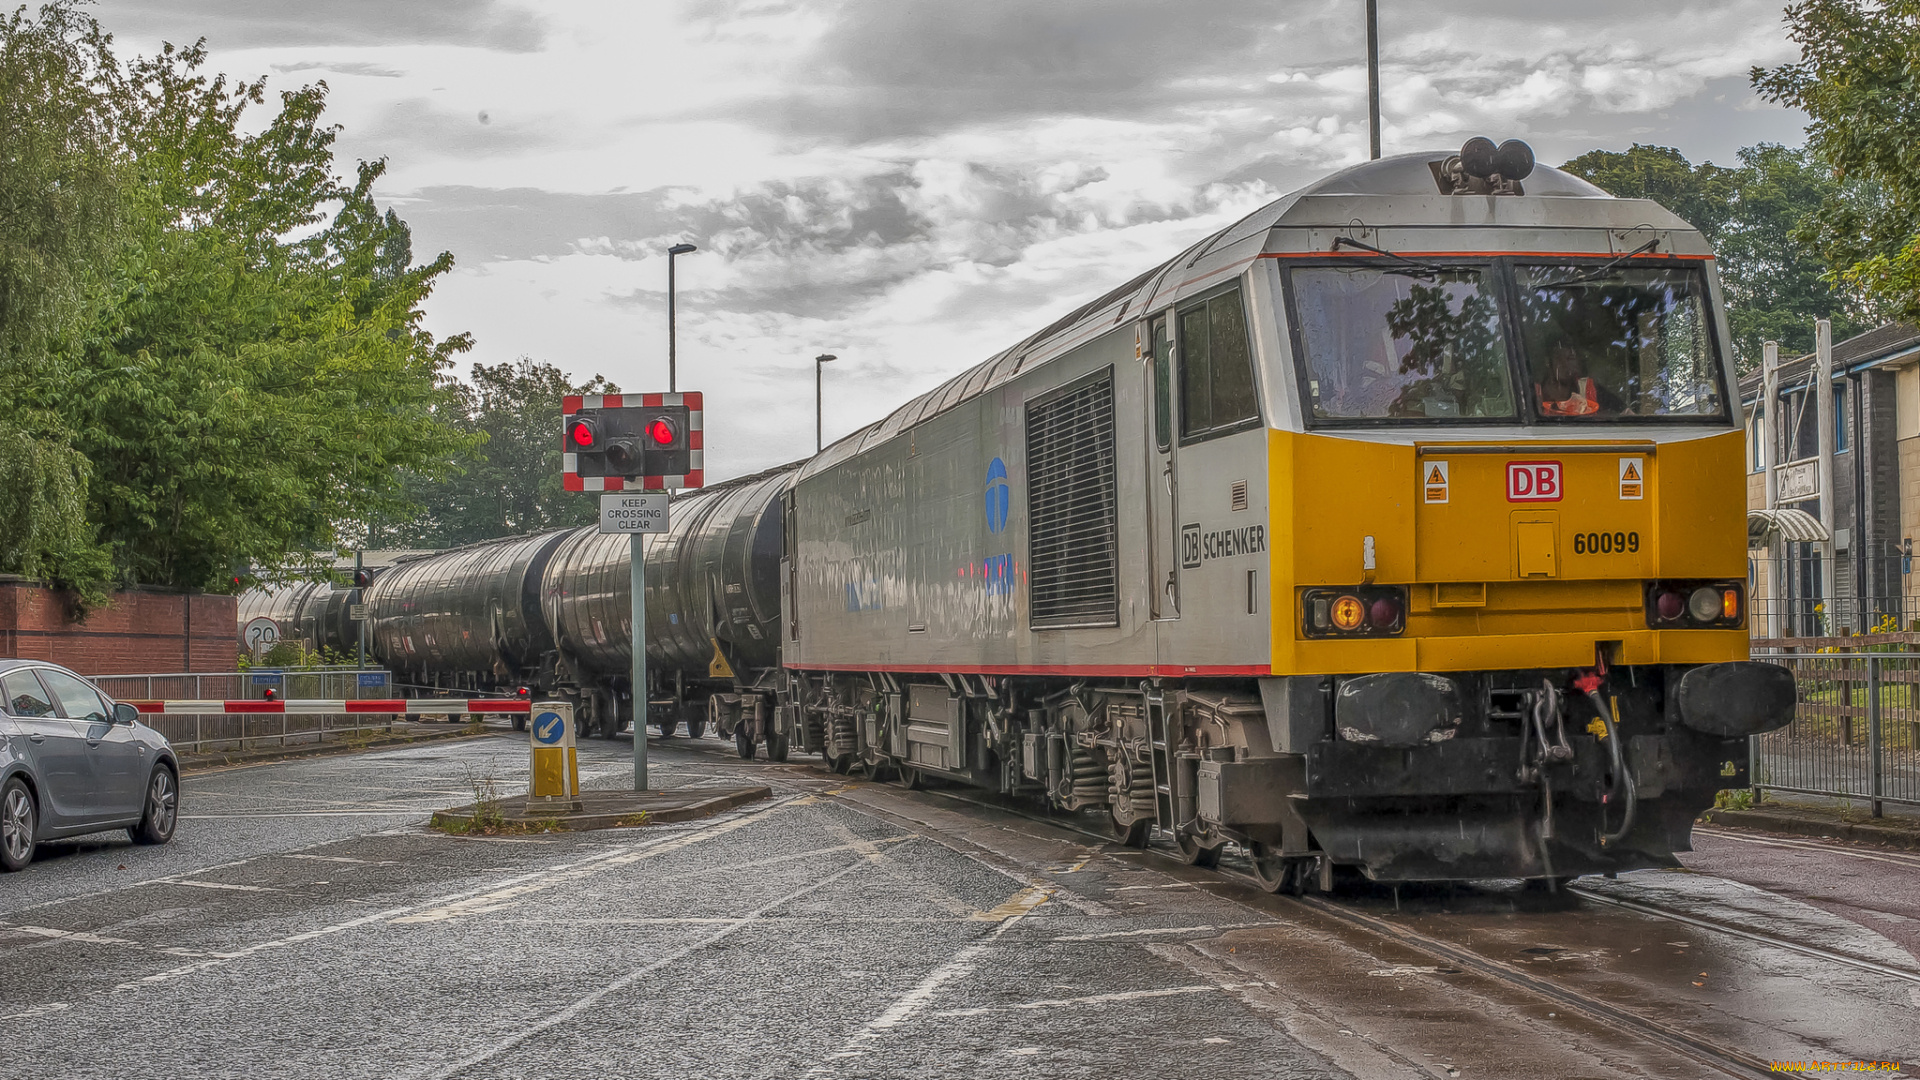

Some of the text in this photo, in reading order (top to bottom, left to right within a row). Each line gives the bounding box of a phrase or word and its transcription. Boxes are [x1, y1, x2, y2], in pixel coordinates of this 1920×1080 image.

[1512, 467, 1557, 496] DB
[621, 498, 647, 508] KEEP
[607, 509, 661, 519] CROSSING
[618, 520, 651, 530] CLEAR
[1183, 524, 1266, 563] DB SCHENKER
[1573, 531, 1640, 555] 60099
[251, 626, 275, 644] 20
